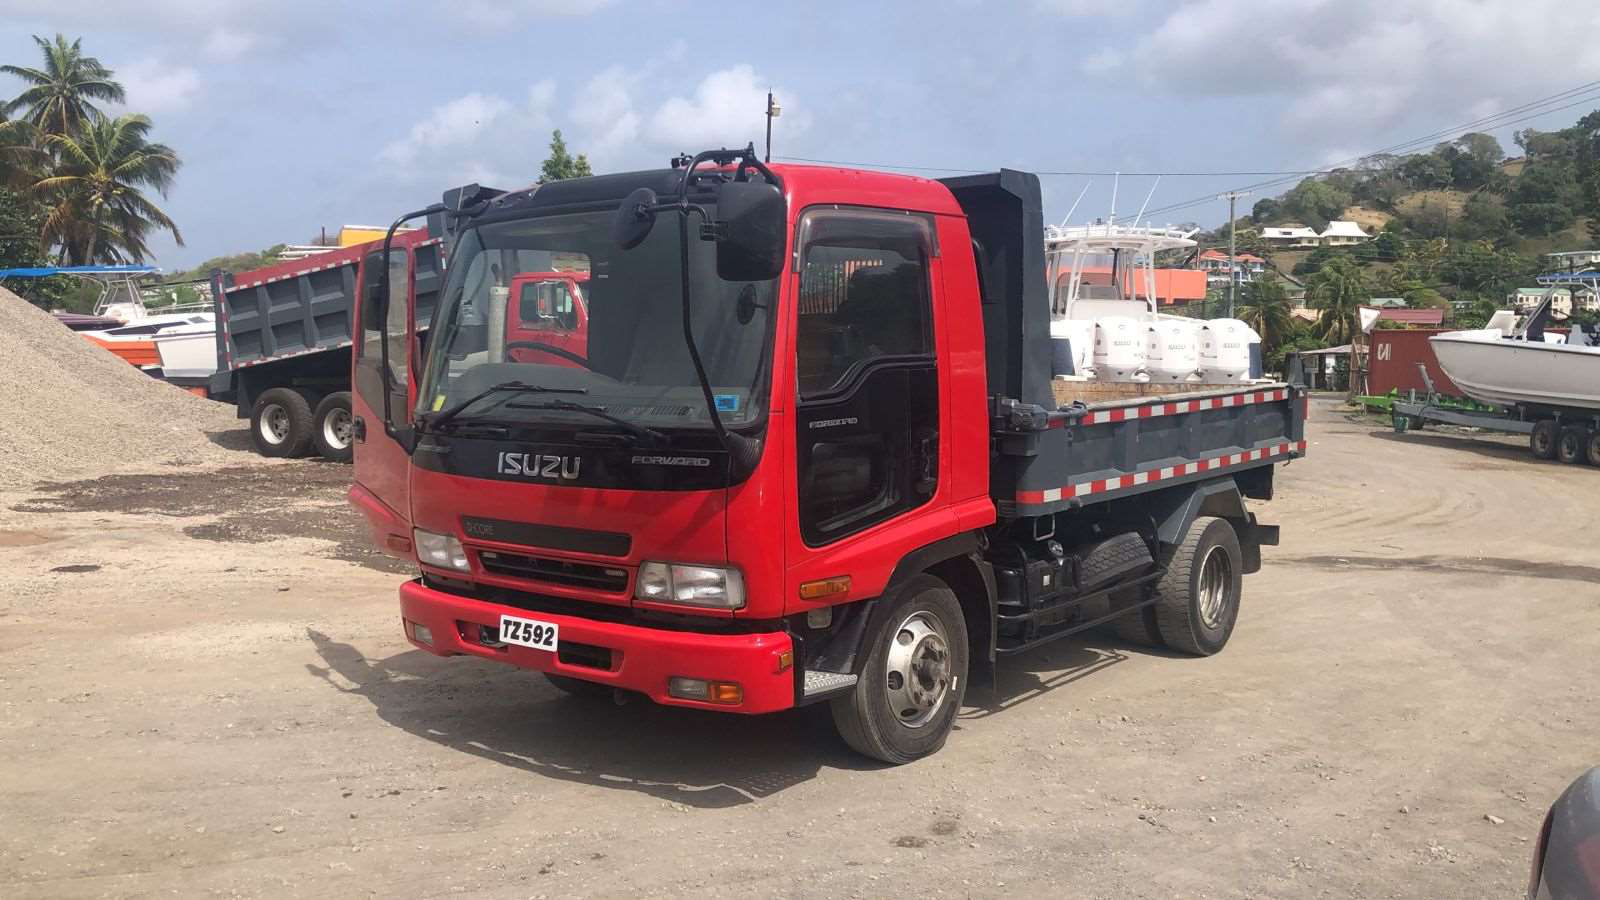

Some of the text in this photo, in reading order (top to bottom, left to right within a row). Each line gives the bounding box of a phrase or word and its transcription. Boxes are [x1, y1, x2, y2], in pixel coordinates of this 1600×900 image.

[497, 451, 581, 480] ISUZU
[631, 455, 711, 467] FORWARD
[503, 619, 555, 647] TZ592
